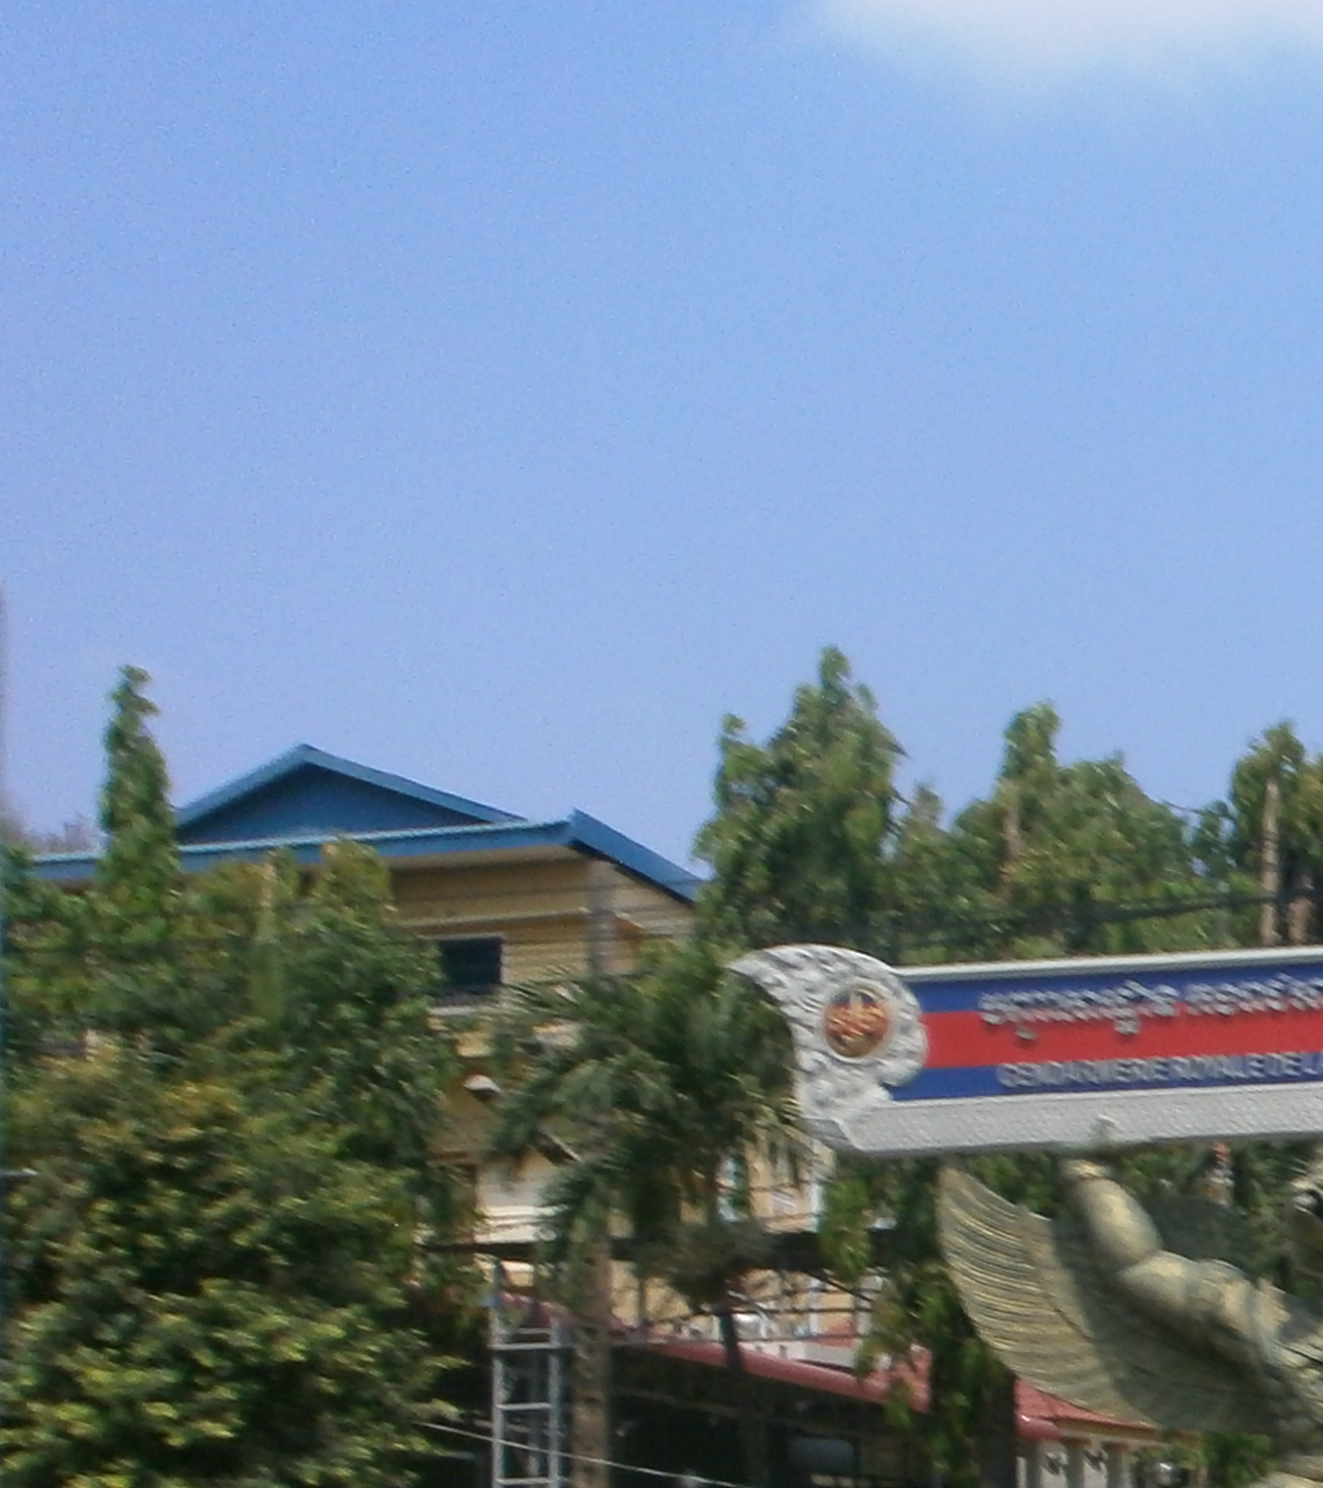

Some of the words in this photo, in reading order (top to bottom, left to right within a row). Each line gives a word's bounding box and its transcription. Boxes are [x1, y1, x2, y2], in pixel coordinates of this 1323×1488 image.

[1000, 1058, 1171, 1088] GENDARMERIE
[1173, 1055, 1263, 1082] ROYALE
[1266, 1053, 1303, 1078] DE
